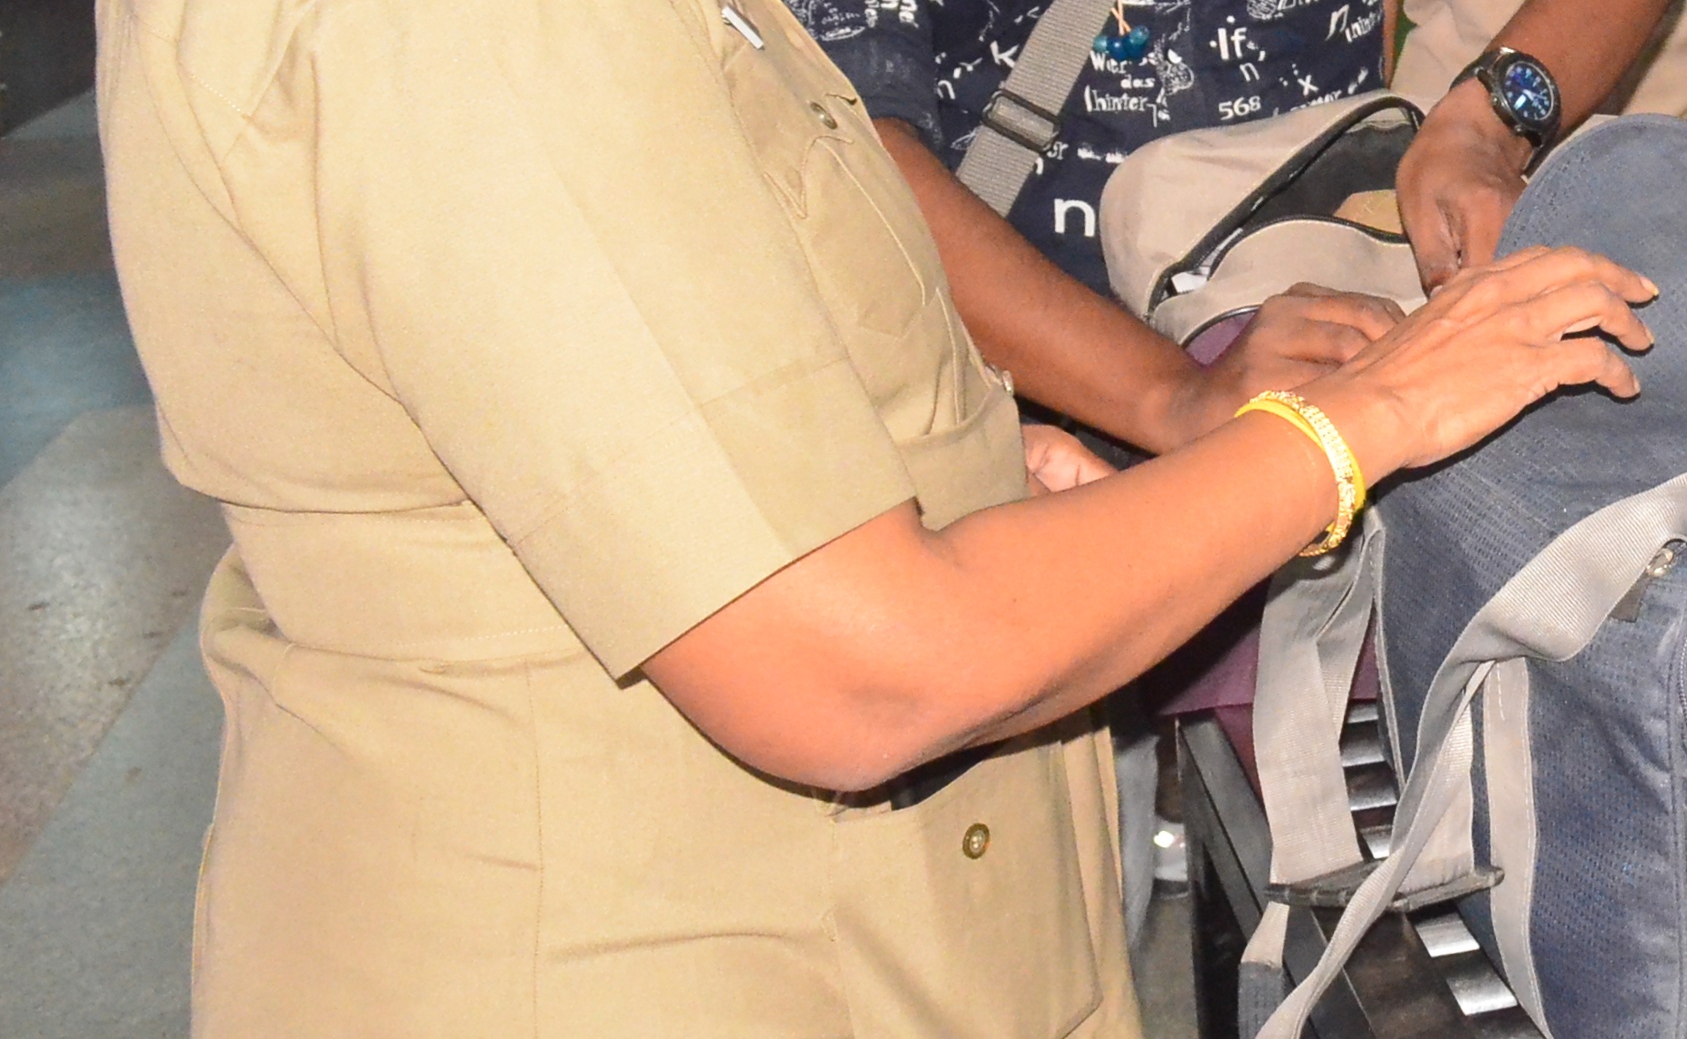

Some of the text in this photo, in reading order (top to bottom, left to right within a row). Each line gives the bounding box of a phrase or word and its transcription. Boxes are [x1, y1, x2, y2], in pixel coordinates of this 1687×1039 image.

[1121, 74, 1155, 90] das
[1218, 95, 1263, 121] 568
[1054, 198, 1096, 237] n
